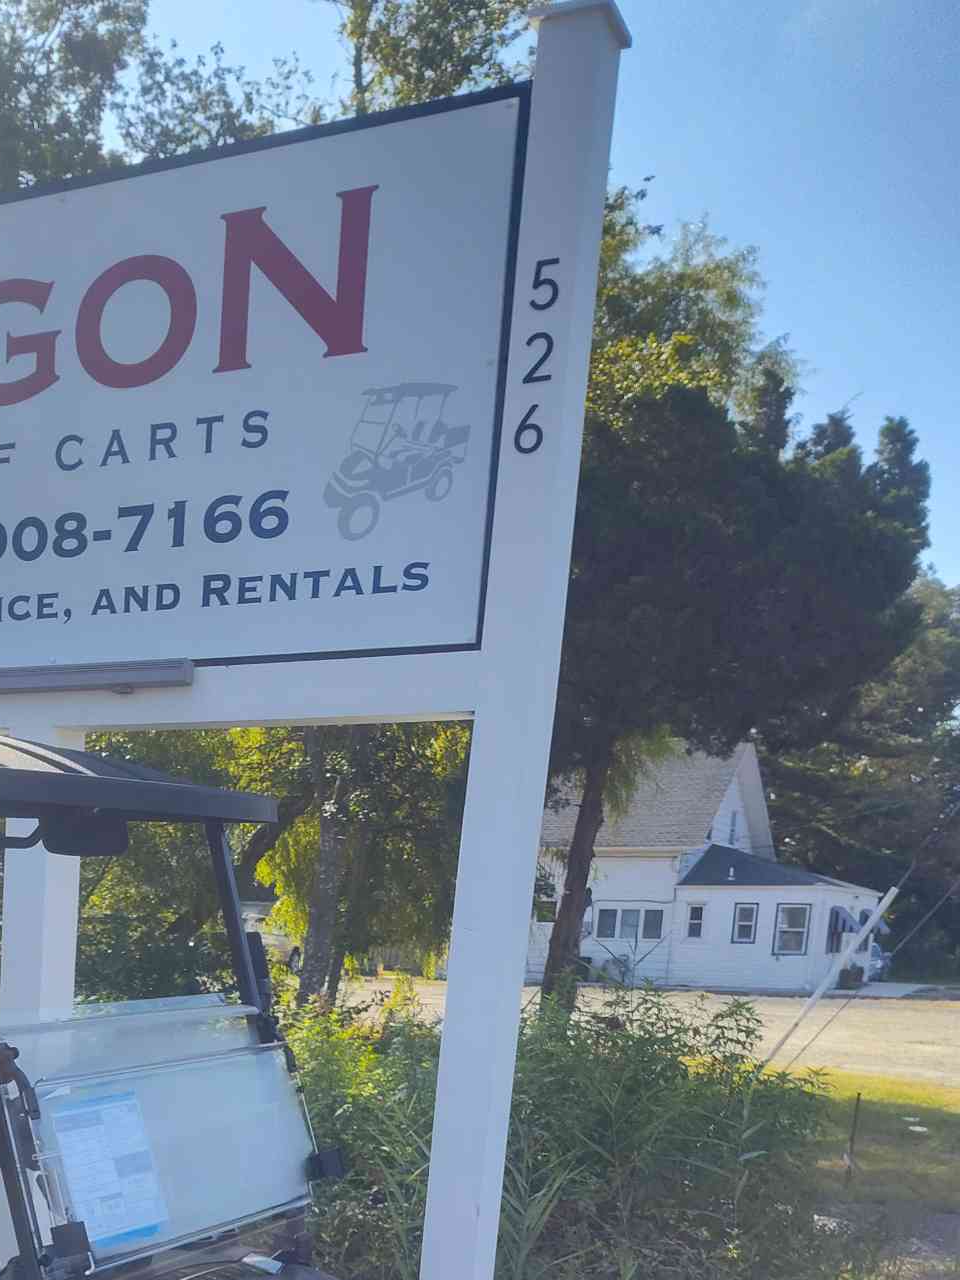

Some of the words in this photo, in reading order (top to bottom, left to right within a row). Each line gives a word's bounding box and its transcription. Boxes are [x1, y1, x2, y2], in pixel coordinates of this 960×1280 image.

[513, 258, 560, 454] 526
[55, 409, 271, 472] CARTS
[91, 582, 181, 616] AND
[201, 561, 431, 607] RENTALS
